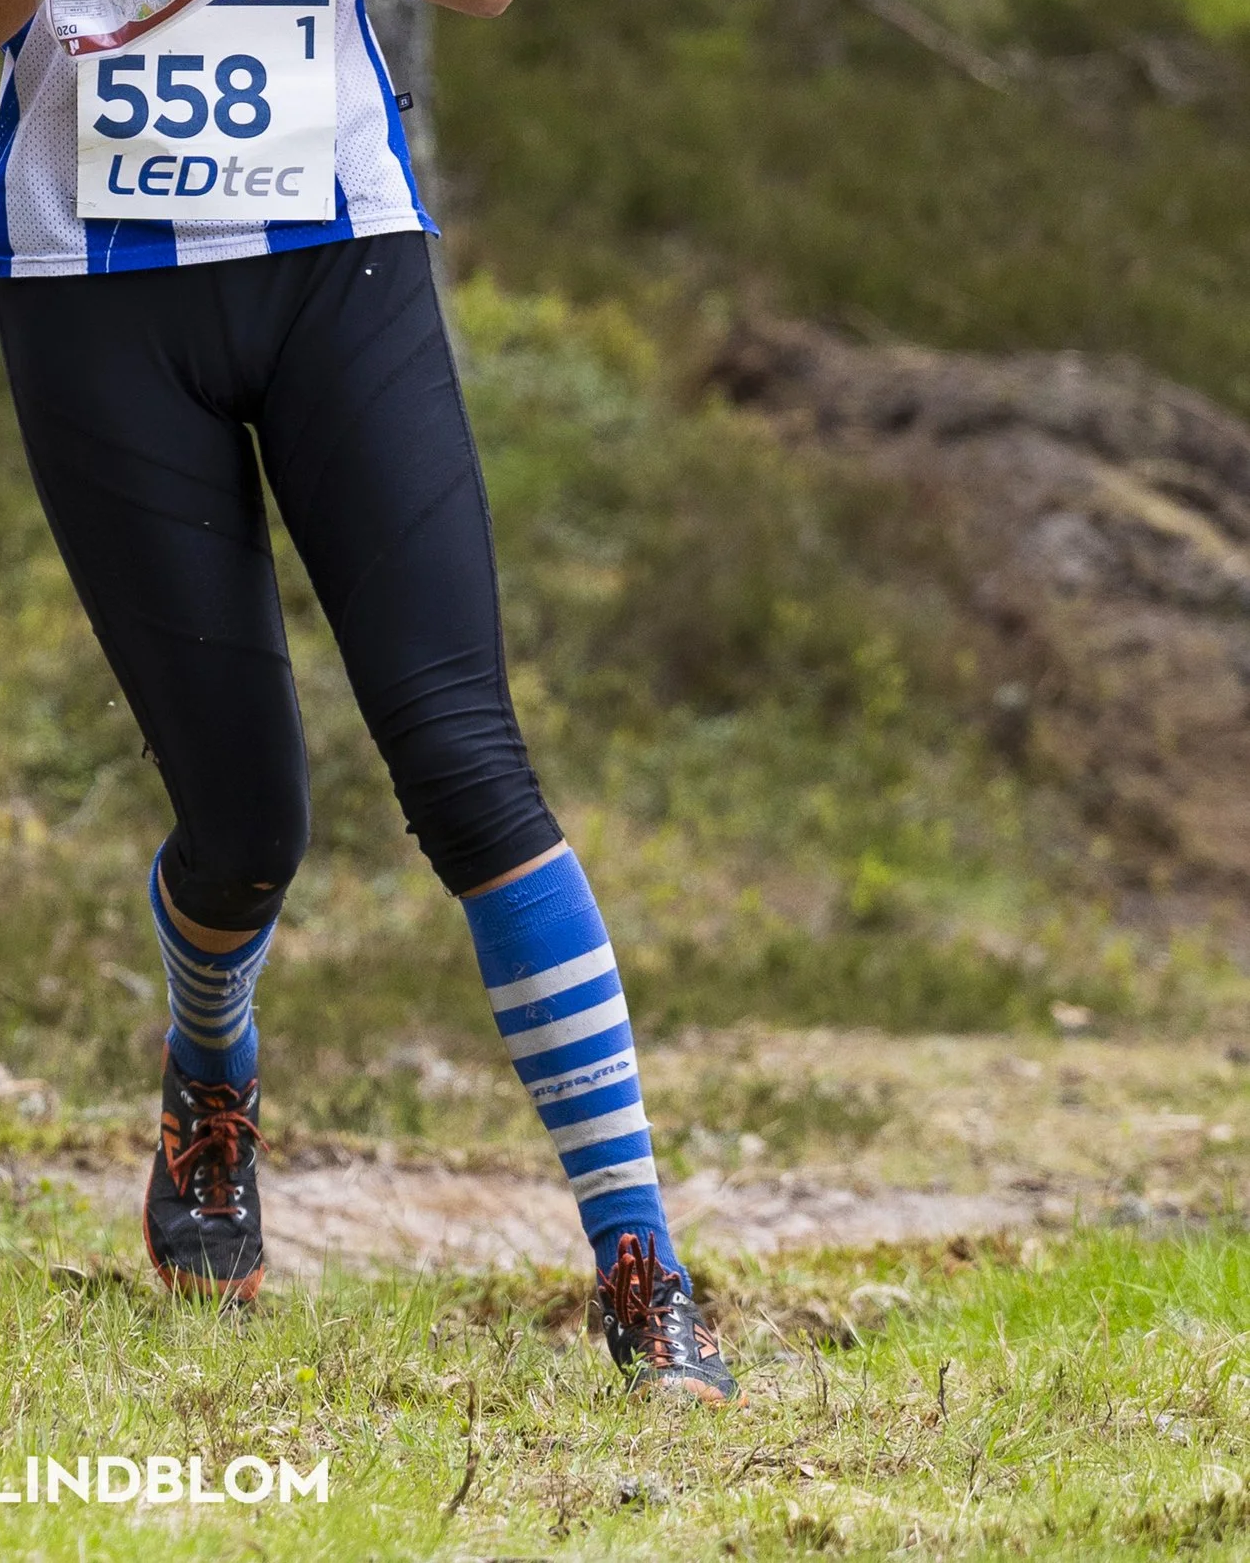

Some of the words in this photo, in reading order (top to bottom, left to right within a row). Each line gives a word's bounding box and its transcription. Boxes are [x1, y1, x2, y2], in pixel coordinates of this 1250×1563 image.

[57, 24, 77, 36] D20
[296, 15, 315, 59] 1
[93, 54, 271, 139] 558
[108, 154, 304, 197] LEDtec
